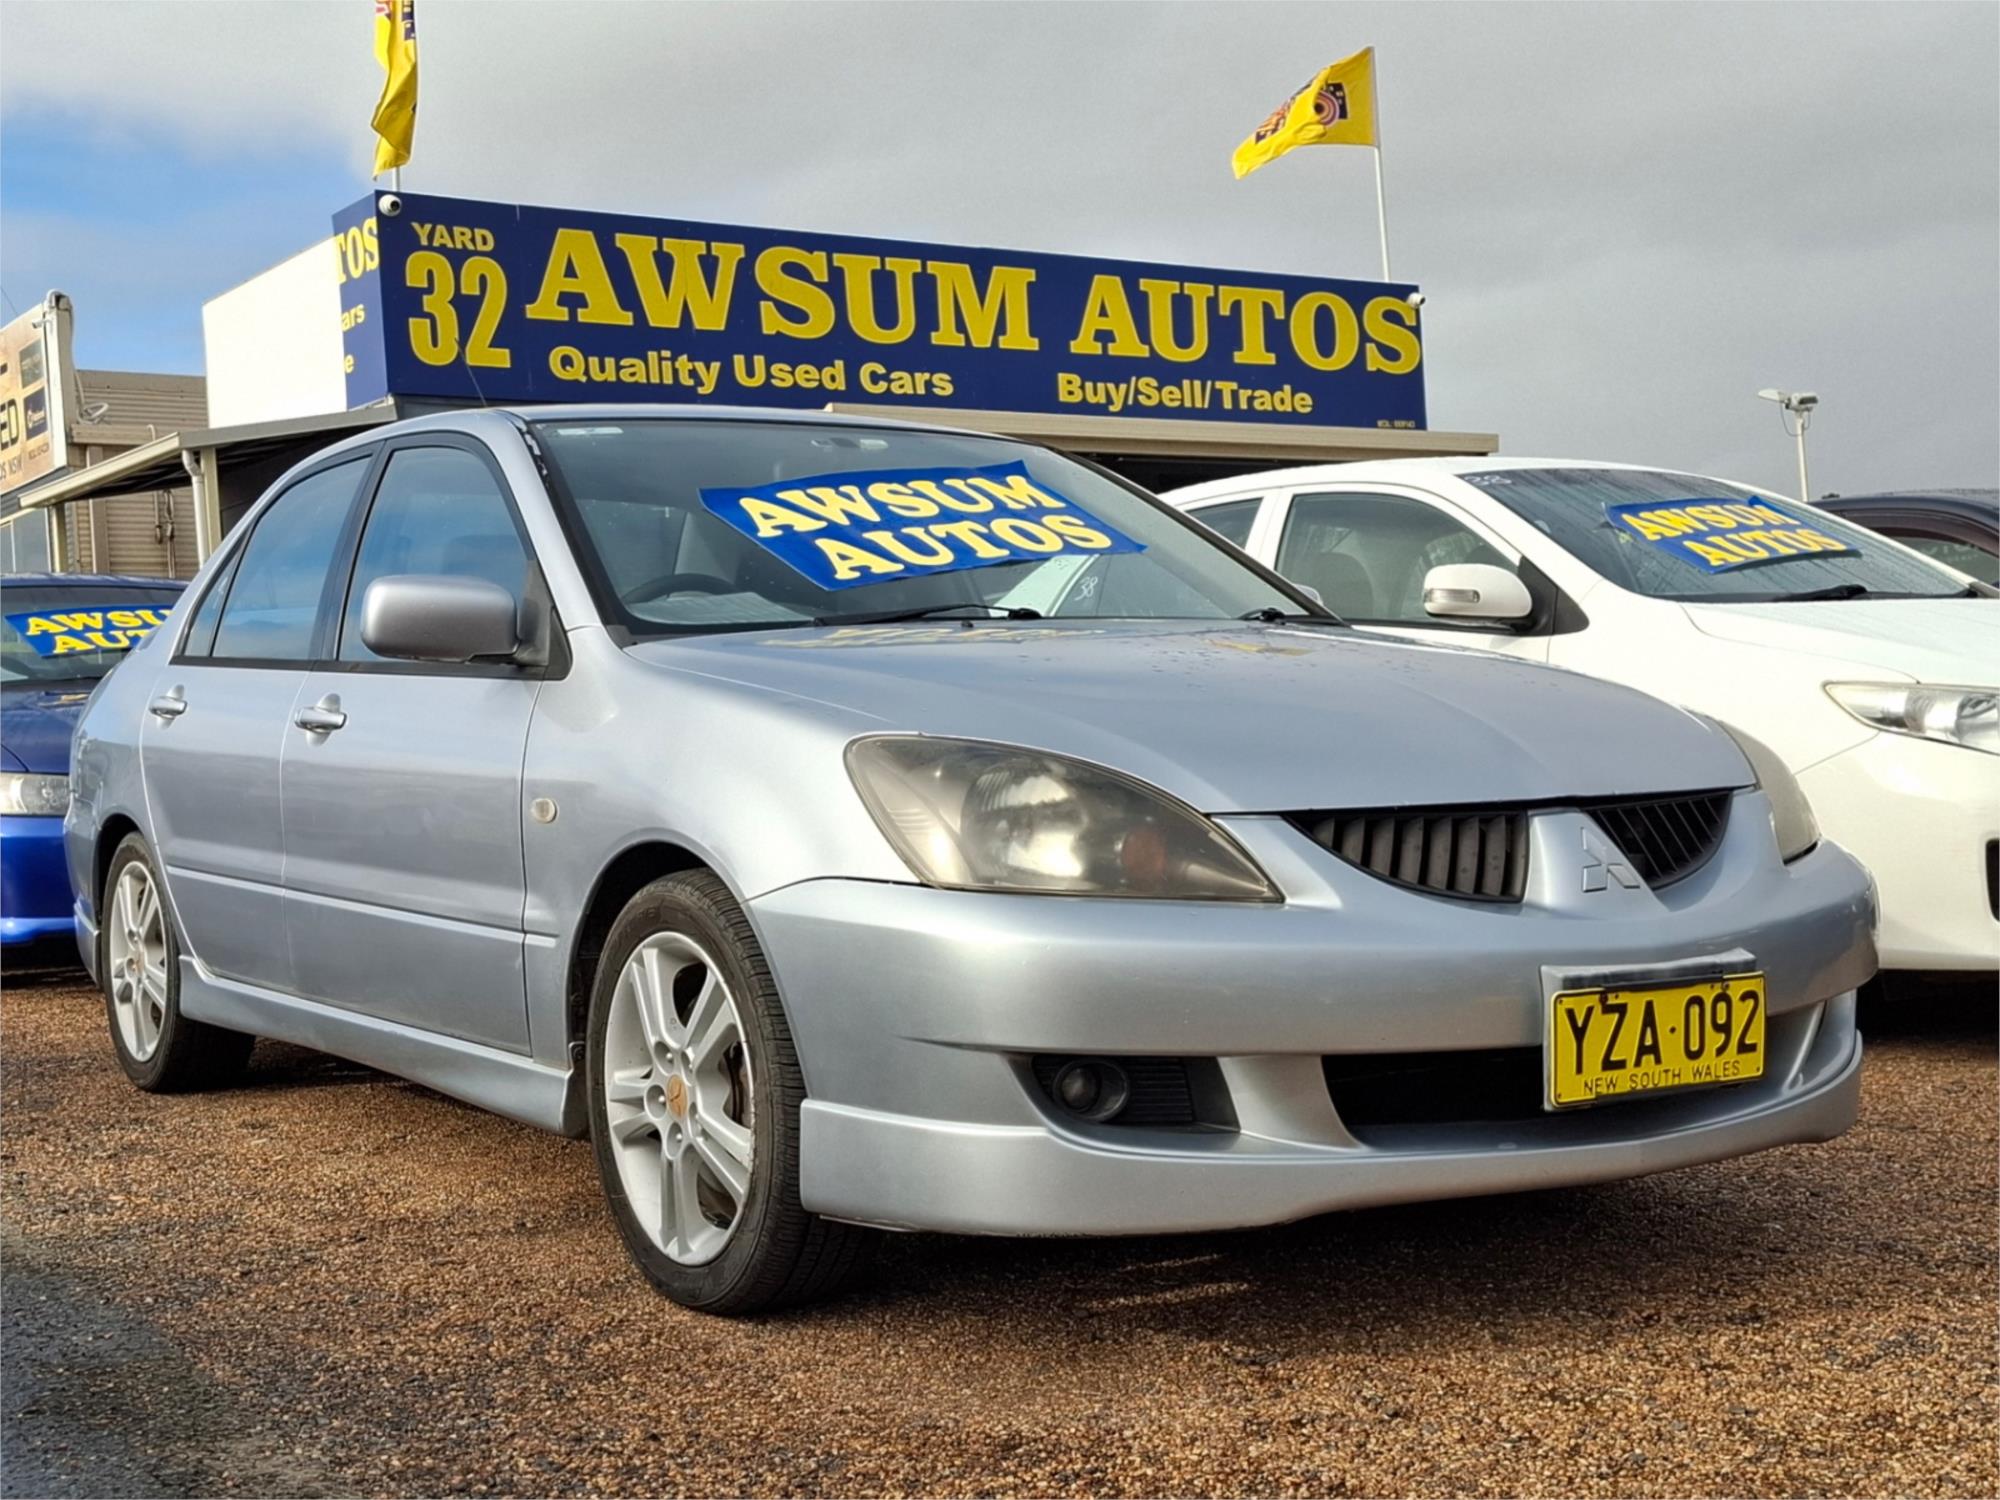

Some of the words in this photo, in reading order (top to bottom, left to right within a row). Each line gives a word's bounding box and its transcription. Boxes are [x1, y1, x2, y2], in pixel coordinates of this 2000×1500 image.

[411, 222, 495, 252] YARD
[404, 250, 513, 370] 32
[524, 228, 1041, 352] AWSUM
[1069, 273, 1424, 376] AUTOS
[549, 345, 721, 396] Quality
[732, 354, 847, 391] Used
[858, 361, 954, 398] Cars
[1057, 371, 1314, 414] Buy/Sell/Trade
[739, 475, 1064, 538] AWSUM
[1621, 505, 1801, 541] AWSUM
[814, 514, 1112, 580] AUTOS
[1682, 528, 1847, 567] AUTOS
[1583, 1075, 1619, 1096] NEW
[1629, 1067, 1682, 1089] SOUTH
[1691, 1059, 1741, 1079] WALES
